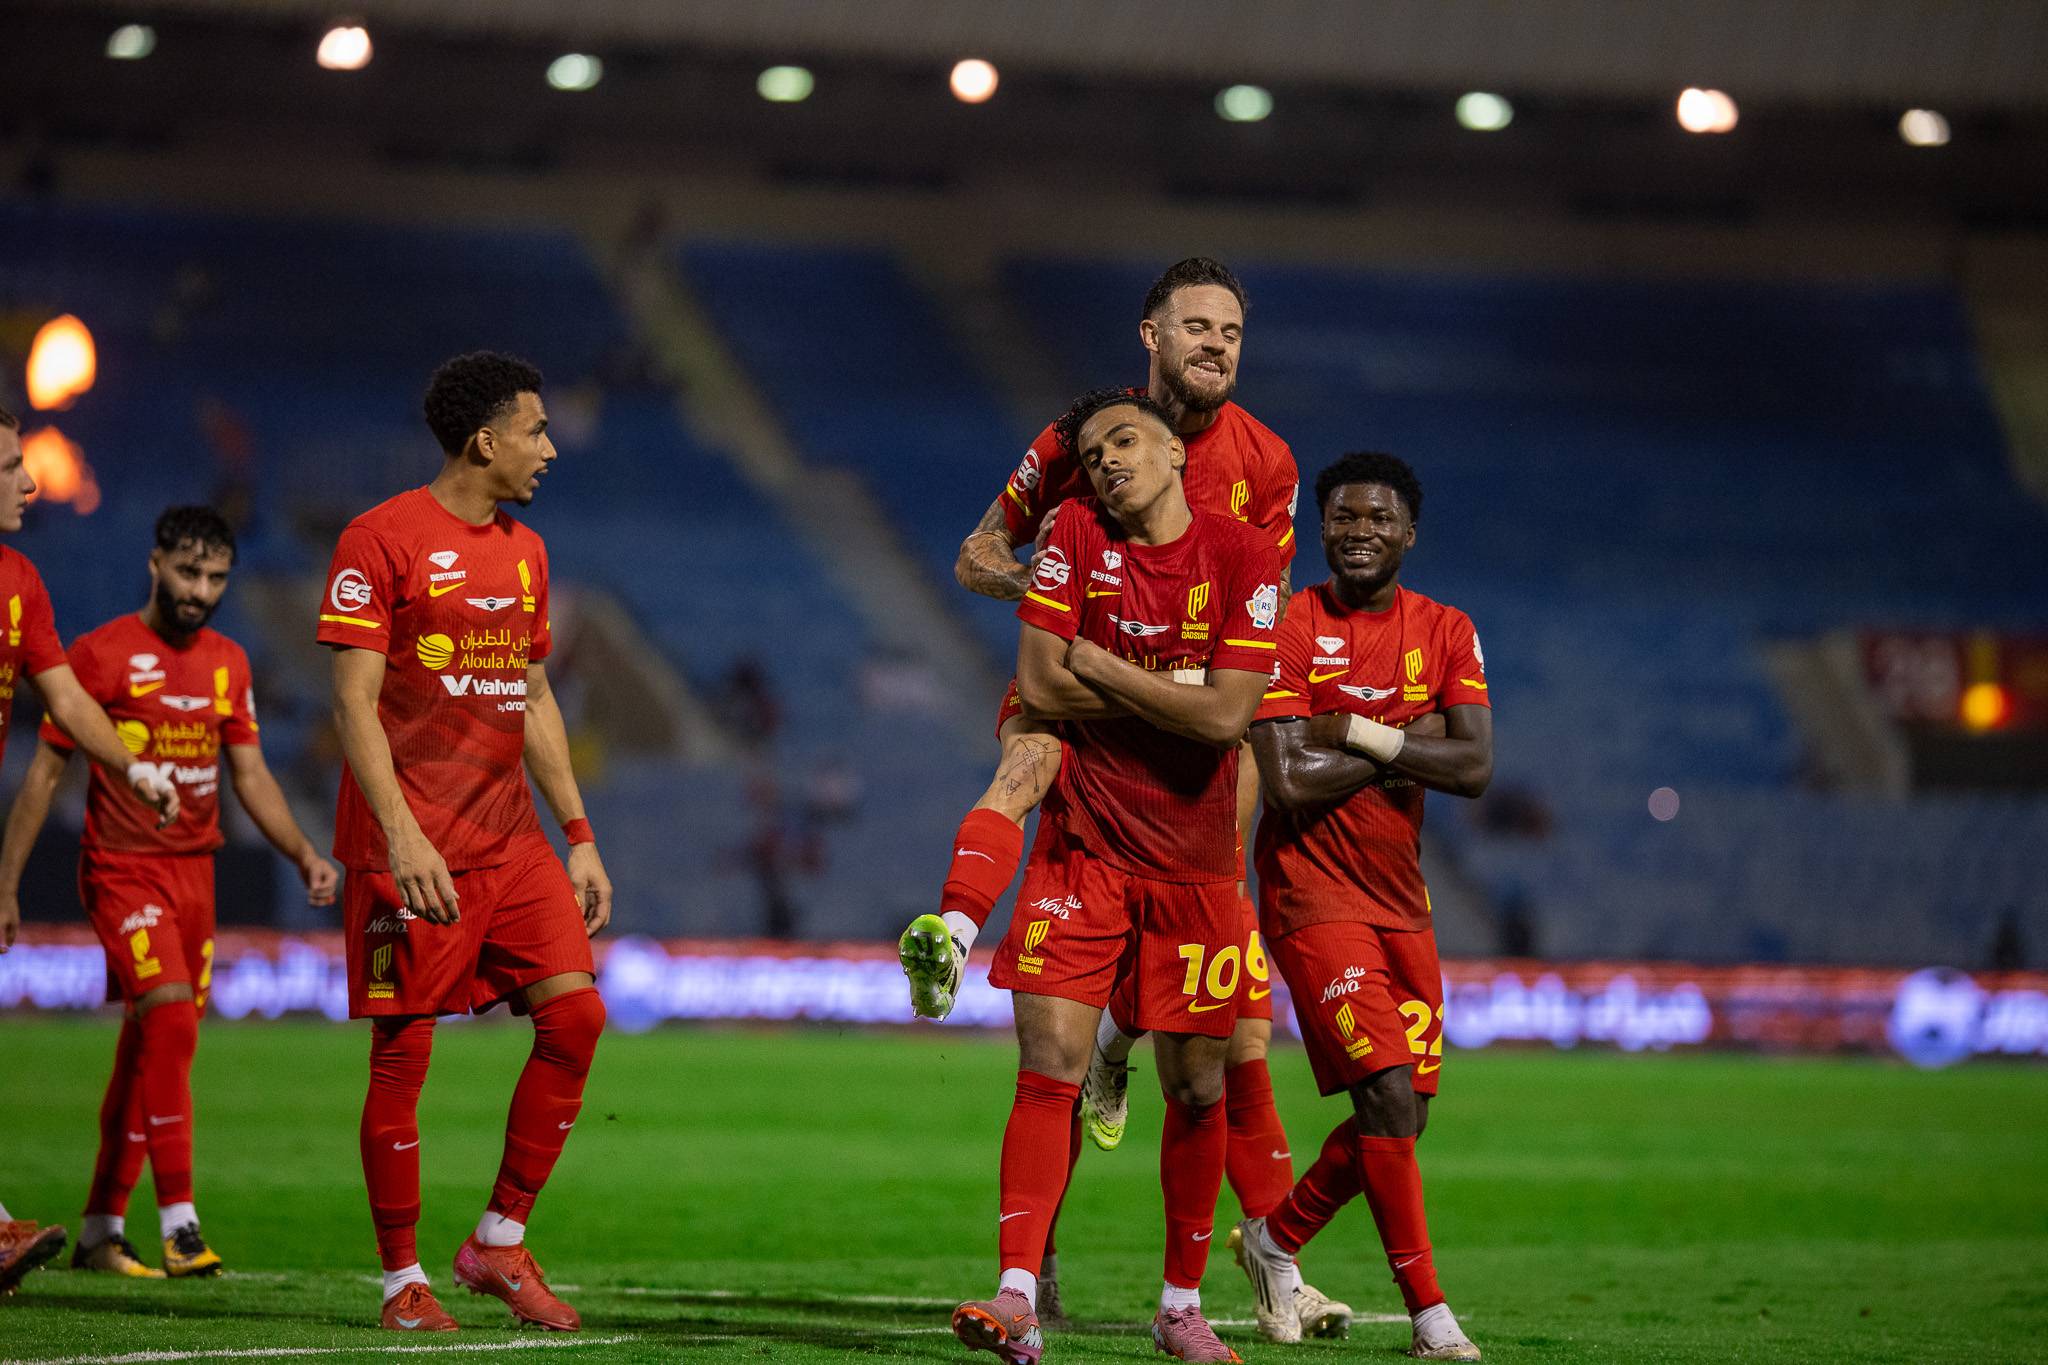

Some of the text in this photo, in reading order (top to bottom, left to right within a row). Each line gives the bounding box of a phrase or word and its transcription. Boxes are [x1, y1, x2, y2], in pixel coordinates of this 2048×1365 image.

[339, 580, 373, 604] SG
[460, 628, 511, 651] للطيران
[1181, 631, 1208, 640] QADSIAH
[459, 652, 504, 669] Aloula
[1031, 897, 1069, 920] Nova
[364, 915, 409, 933] Nova
[1245, 930, 1270, 982] 6
[1179, 943, 1241, 1000] 10
[1320, 977, 1361, 1004] Nova
